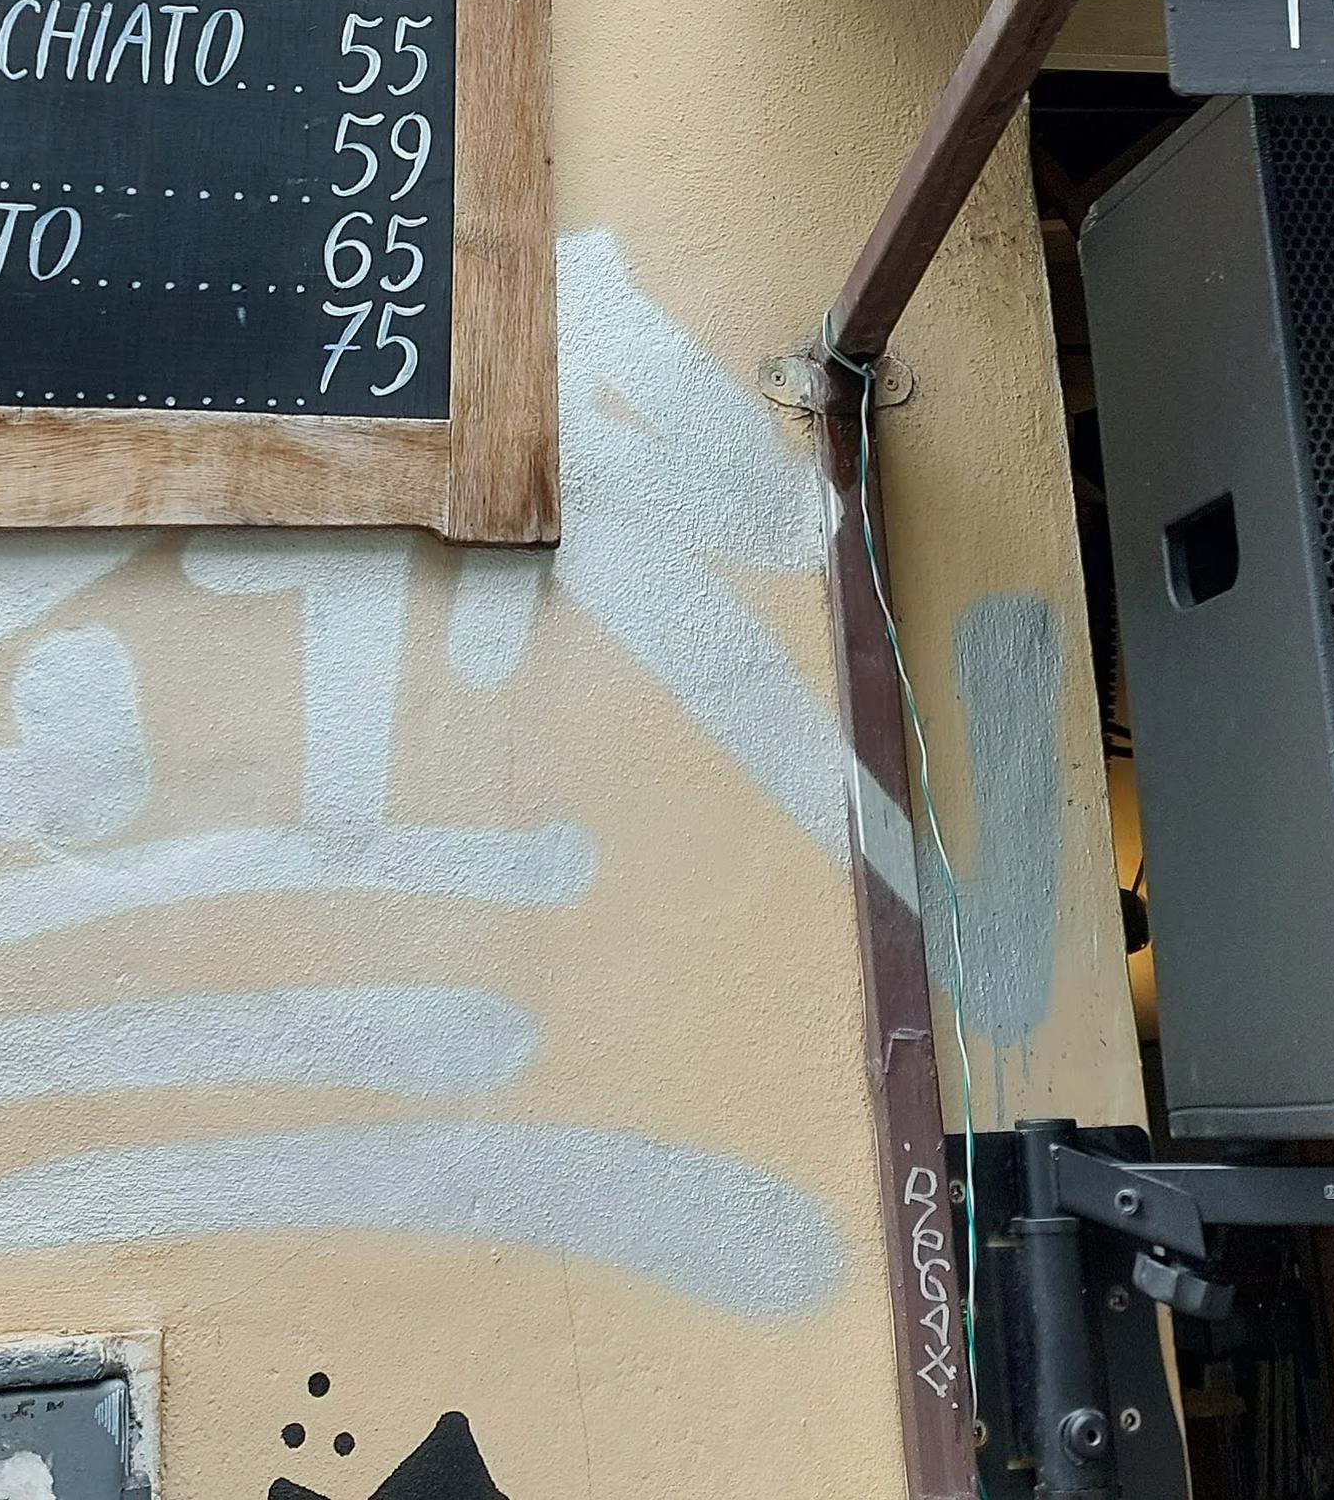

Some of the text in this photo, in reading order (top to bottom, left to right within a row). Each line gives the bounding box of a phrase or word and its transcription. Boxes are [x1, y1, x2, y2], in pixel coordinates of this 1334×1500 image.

[336, 13, 432, 95] 55
[331, 112, 432, 200] 59
[323, 211, 427, 293] 65
[319, 301, 425, 396] 75
